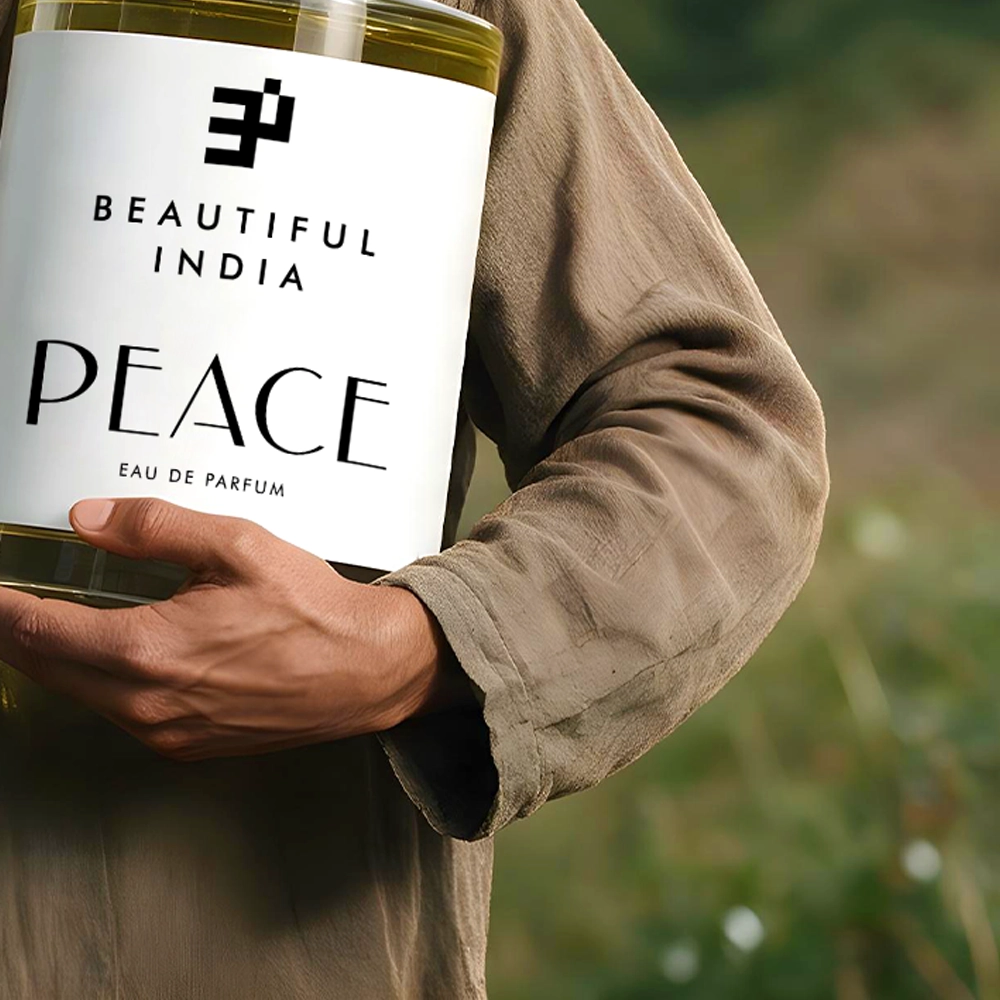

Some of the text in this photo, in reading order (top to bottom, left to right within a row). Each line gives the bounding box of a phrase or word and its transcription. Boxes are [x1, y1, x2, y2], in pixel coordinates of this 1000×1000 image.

[93, 194, 377, 258] BEAUTIFUL
[153, 245, 305, 292] INDIA
[25, 339, 391, 472] PEACE
[118, 462, 286, 498] EAU DE PARFUM
